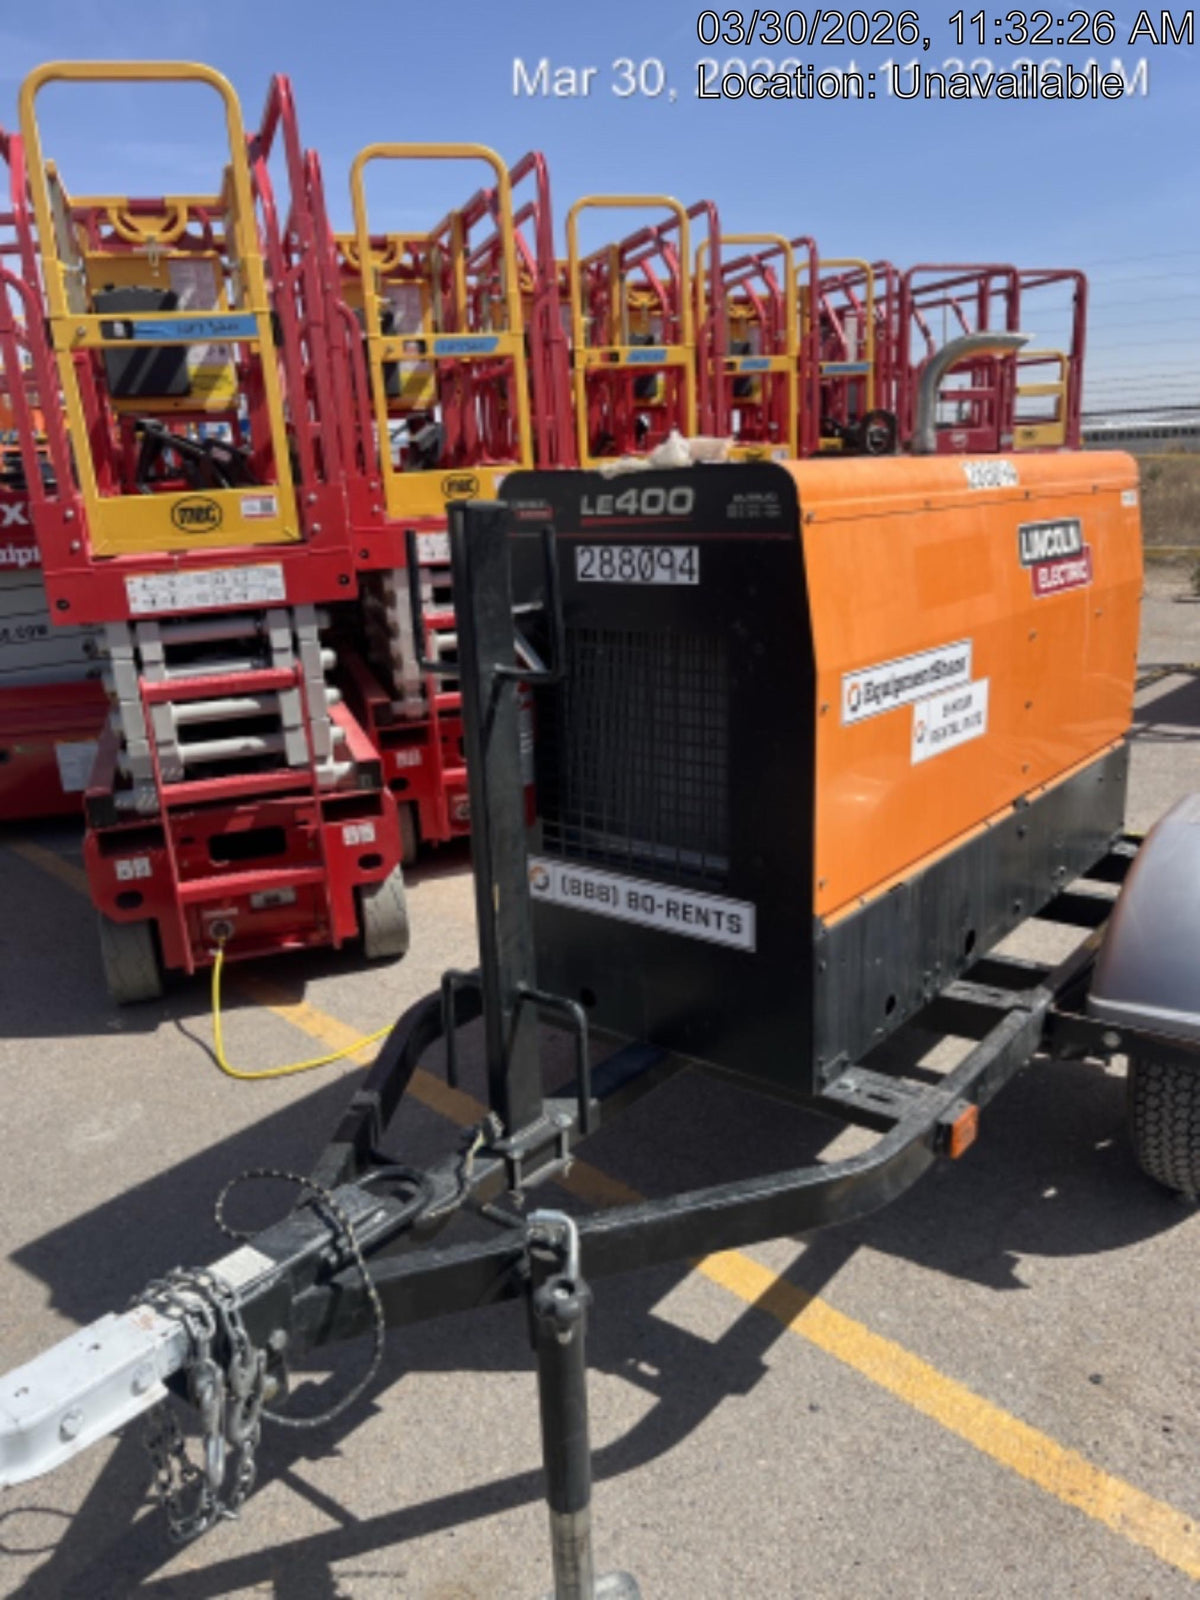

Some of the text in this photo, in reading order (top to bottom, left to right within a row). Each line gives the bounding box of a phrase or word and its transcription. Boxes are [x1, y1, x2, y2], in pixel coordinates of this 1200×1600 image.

[580, 486, 695, 516] LE400
[578, 547, 696, 582] 288094
[1037, 559, 1088, 589] ELECTRIC
